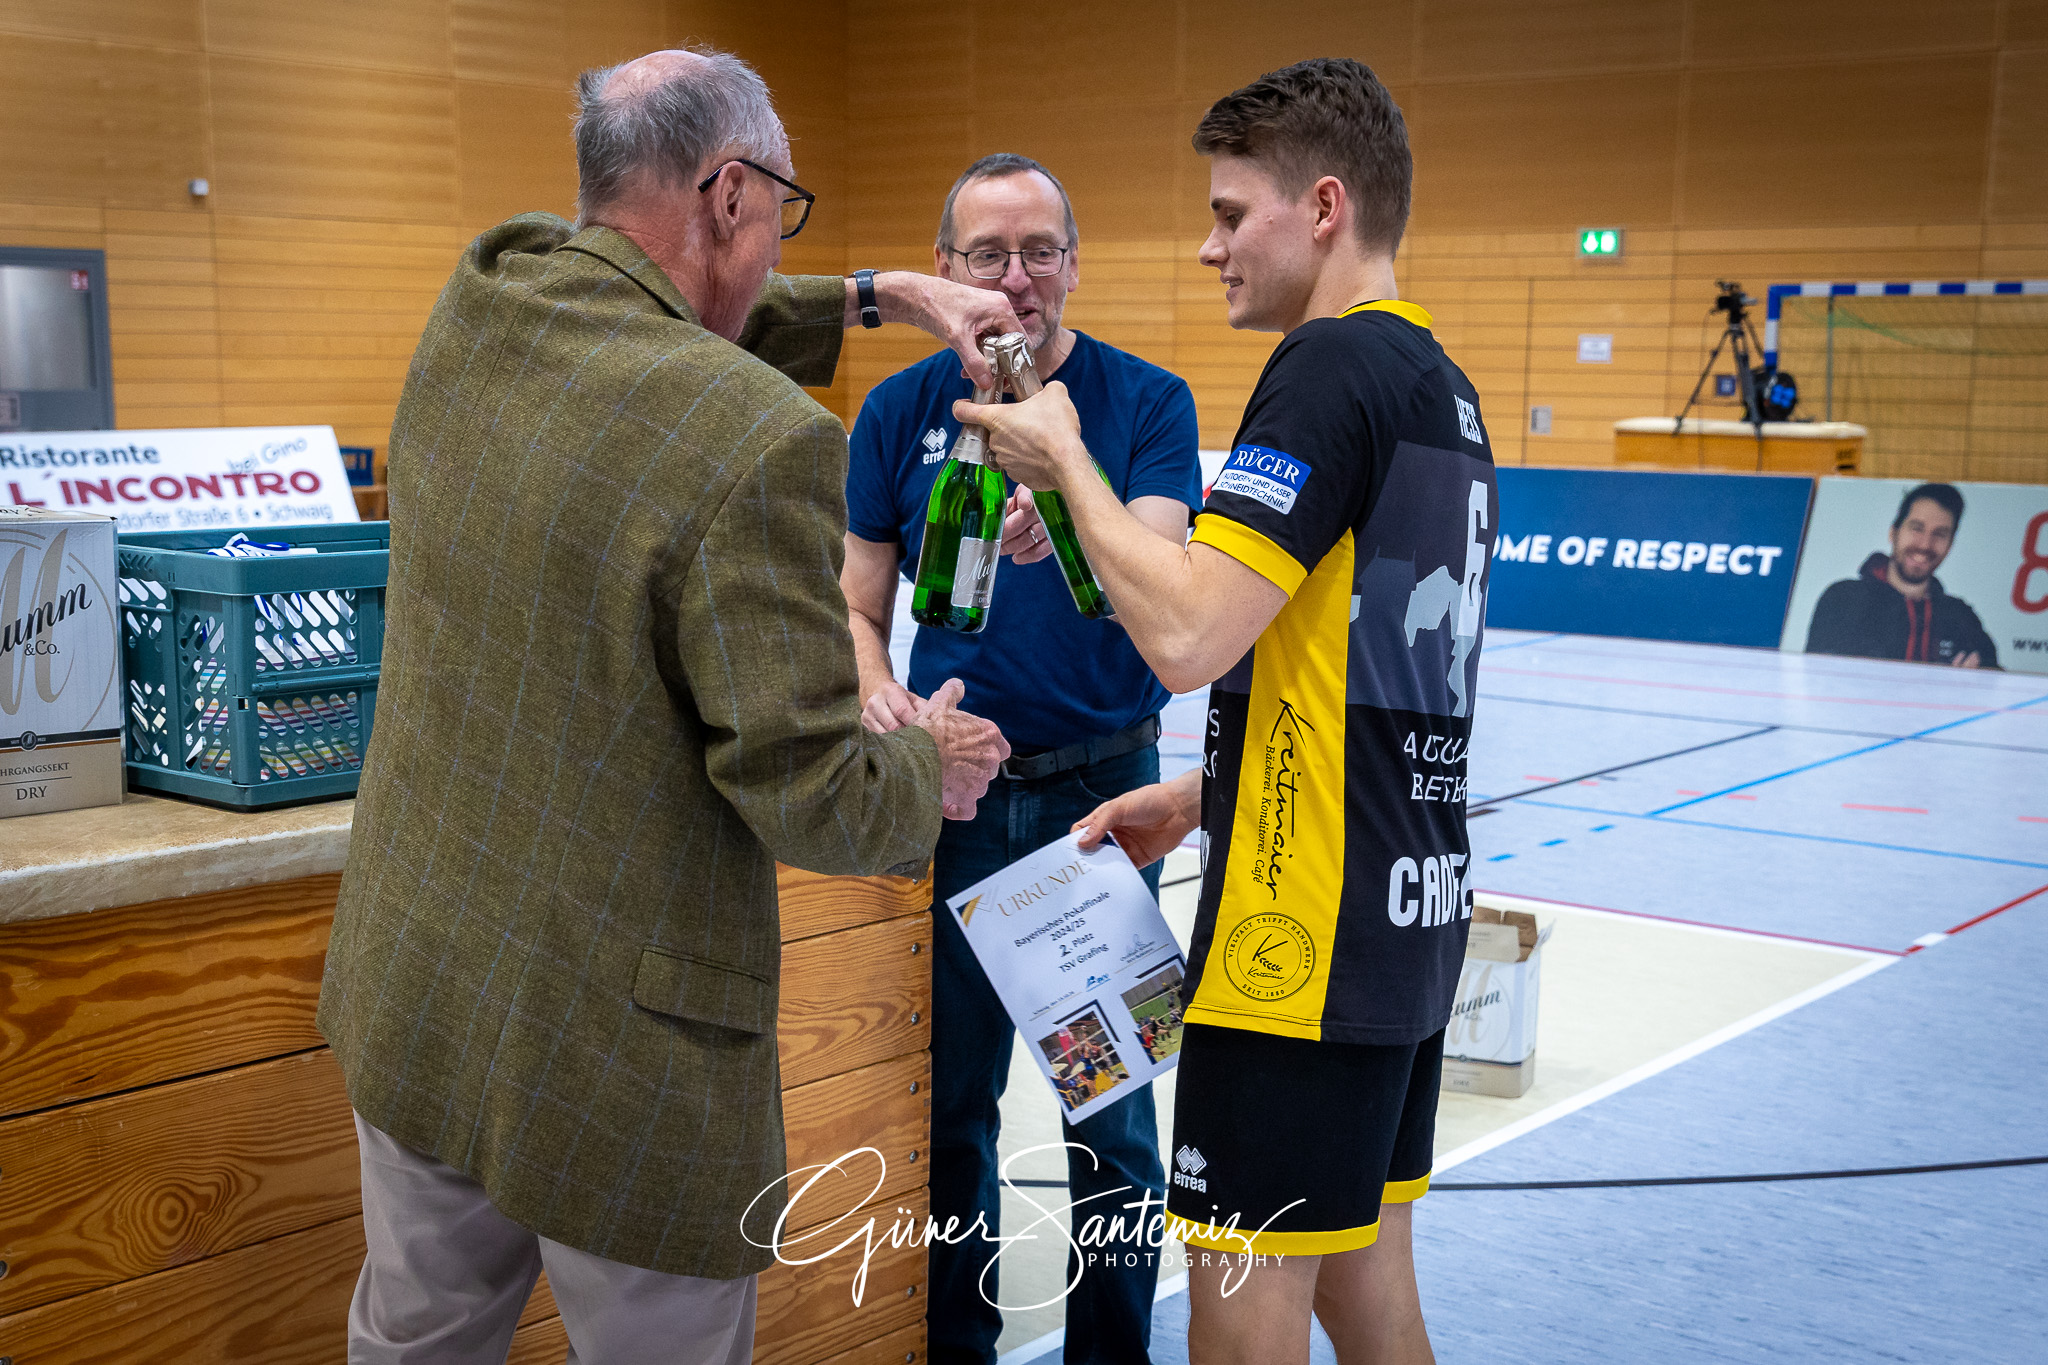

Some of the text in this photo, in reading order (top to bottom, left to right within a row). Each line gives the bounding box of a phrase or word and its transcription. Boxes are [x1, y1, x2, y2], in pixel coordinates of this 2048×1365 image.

[1454, 394, 1484, 445] HESS
[0, 443, 161, 468] Ristorante
[1233, 447, 1300, 485] RÜGER
[1252, 478, 1270, 489] UND
[1270, 485, 1292, 500] LASER
[117, 502, 334, 531] dorfer Straße 6 Schwaig
[1456, 479, 1488, 637] 6
[1557, 536, 1609, 567] OF
[1612, 538, 1783, 577] RESPECT
[0, 583, 93, 657] umm
[24, 640, 61, 656] &Co.
[0, 762, 70, 777] HRGANGSSEKT
[16, 786, 48, 801] DRY
[1252, 744, 1276, 884] Bäckerei. Konditorei. Café
[997, 858, 1093, 917] URKUNDE
[1387, 852, 1474, 928] CADFE
[1013, 891, 1110, 948] Bayerisches Pokalfinale
[1049, 917, 1087, 942] 2024/25
[1071, 932, 1096, 948] Platz
[1290, 924, 1312, 970] HANDWERK
[1057, 958, 1077, 973] TSV
[1076, 943, 1110, 964] Grafing
[1452, 989, 1501, 1017] umm
[1174, 1171, 1207, 1193] errea
